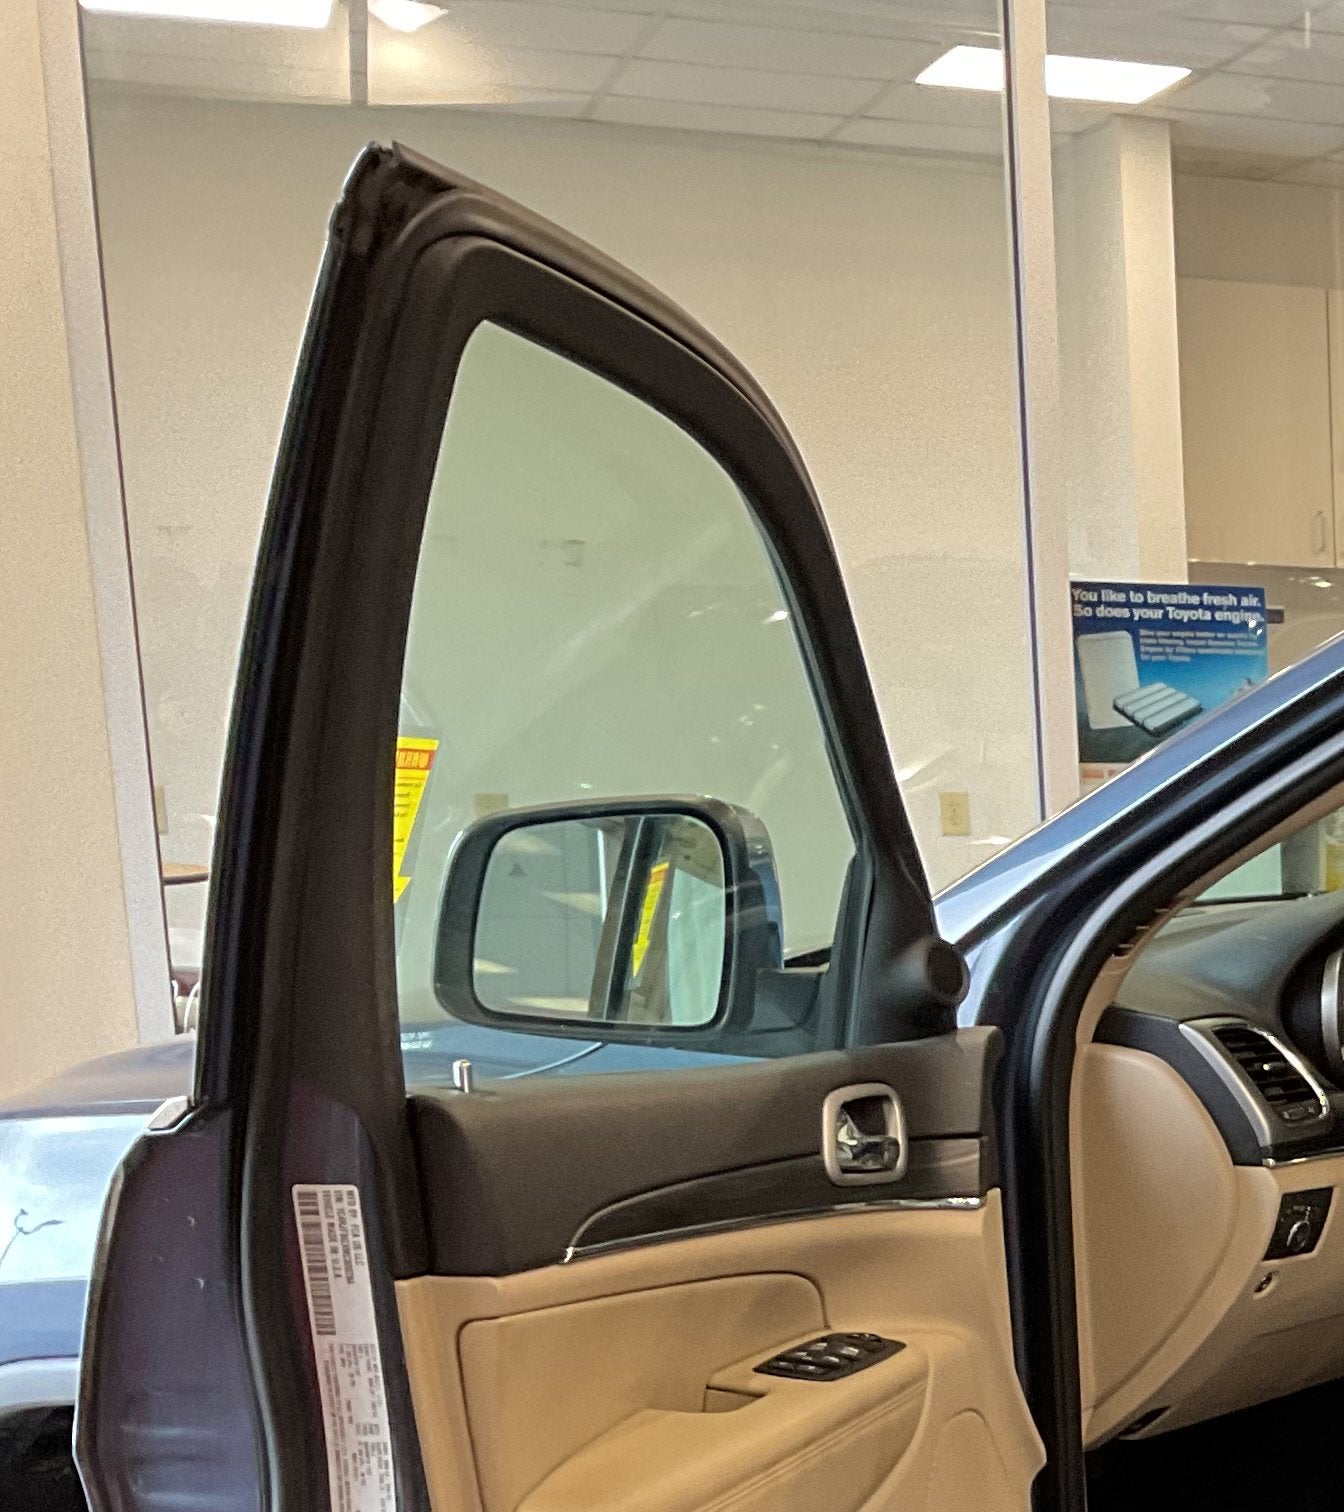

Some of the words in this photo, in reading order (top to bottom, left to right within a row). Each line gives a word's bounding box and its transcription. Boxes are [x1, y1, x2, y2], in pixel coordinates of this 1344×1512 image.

[1072, 588, 1098, 602] You
[1101, 590, 1126, 602] like
[1130, 590, 1144, 603] to
[1147, 591, 1200, 605] breathe
[1203, 592, 1238, 606] fresh
[1240, 593, 1262, 607] air.
[1073, 604, 1093, 617] So
[1096, 605, 1130, 618] does
[1133, 607, 1165, 621] your
[1166, 607, 1212, 622] Toyota
